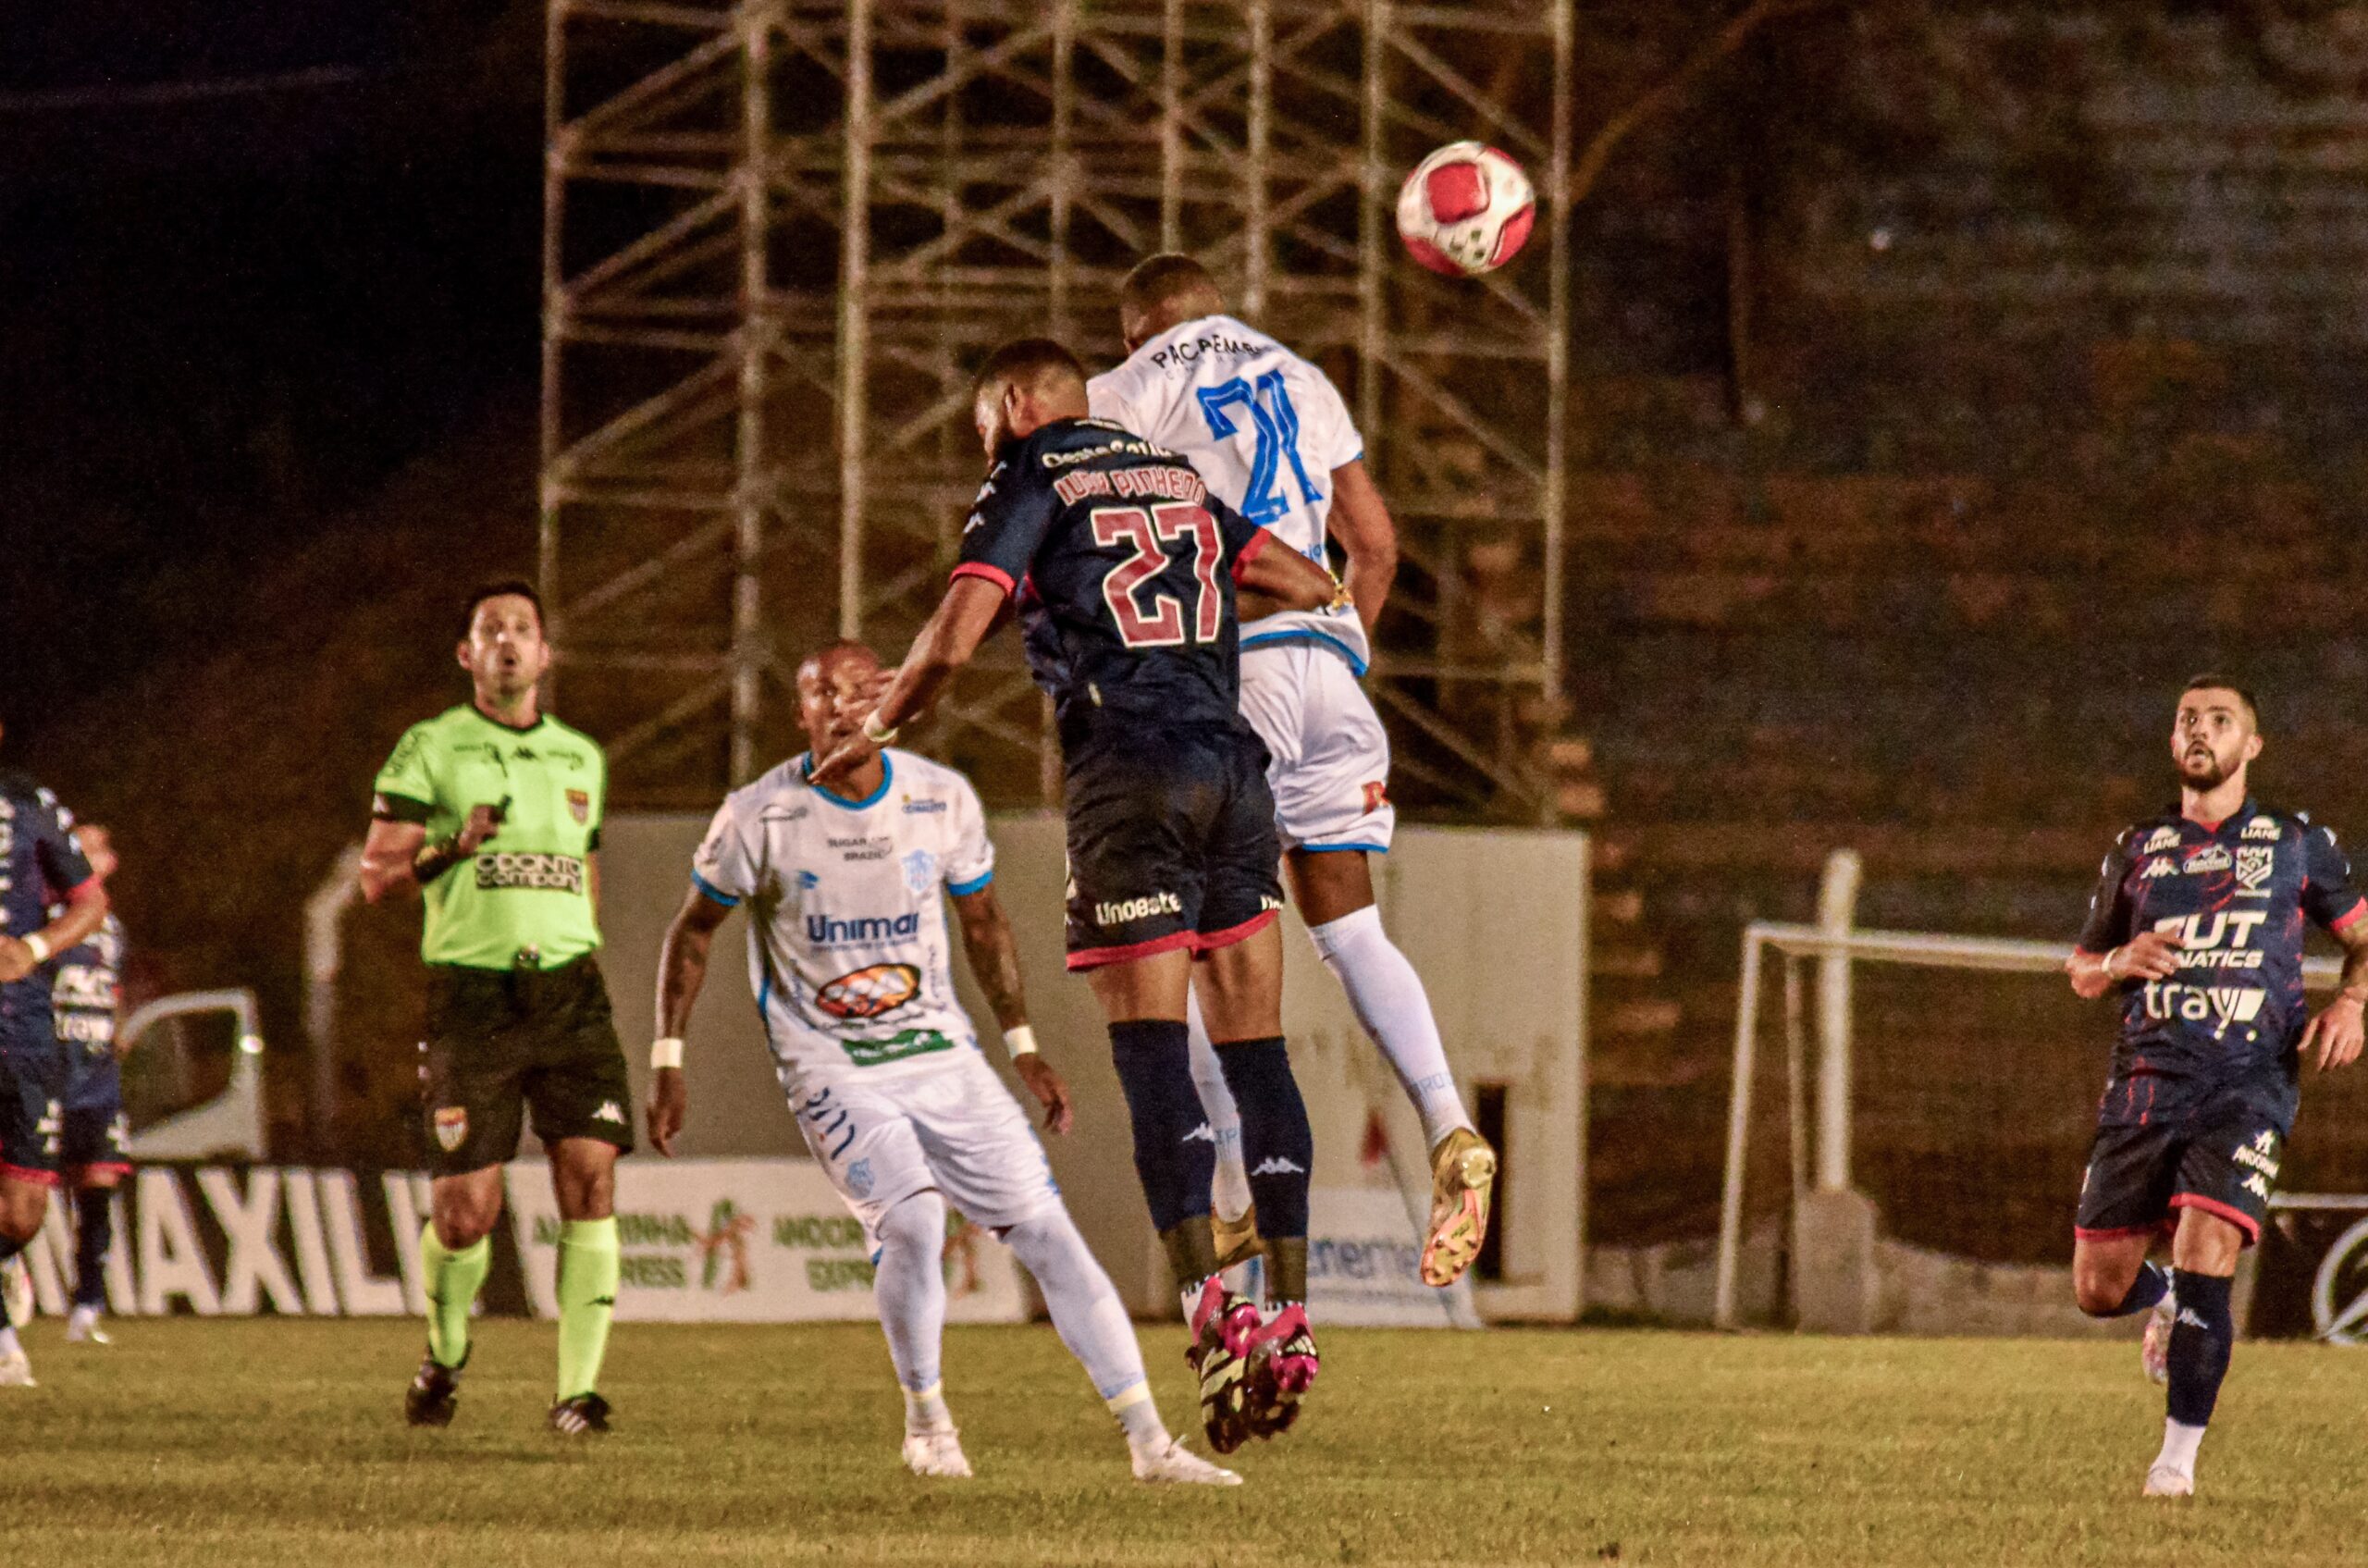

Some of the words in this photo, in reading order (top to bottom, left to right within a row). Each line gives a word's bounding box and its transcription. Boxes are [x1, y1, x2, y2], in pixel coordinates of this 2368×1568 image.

[1091, 502, 1222, 648] 27
[1096, 892, 1181, 926] Unoeste
[2174, 950, 2264, 969] NATICS
[2143, 980, 2238, 1041] tray
